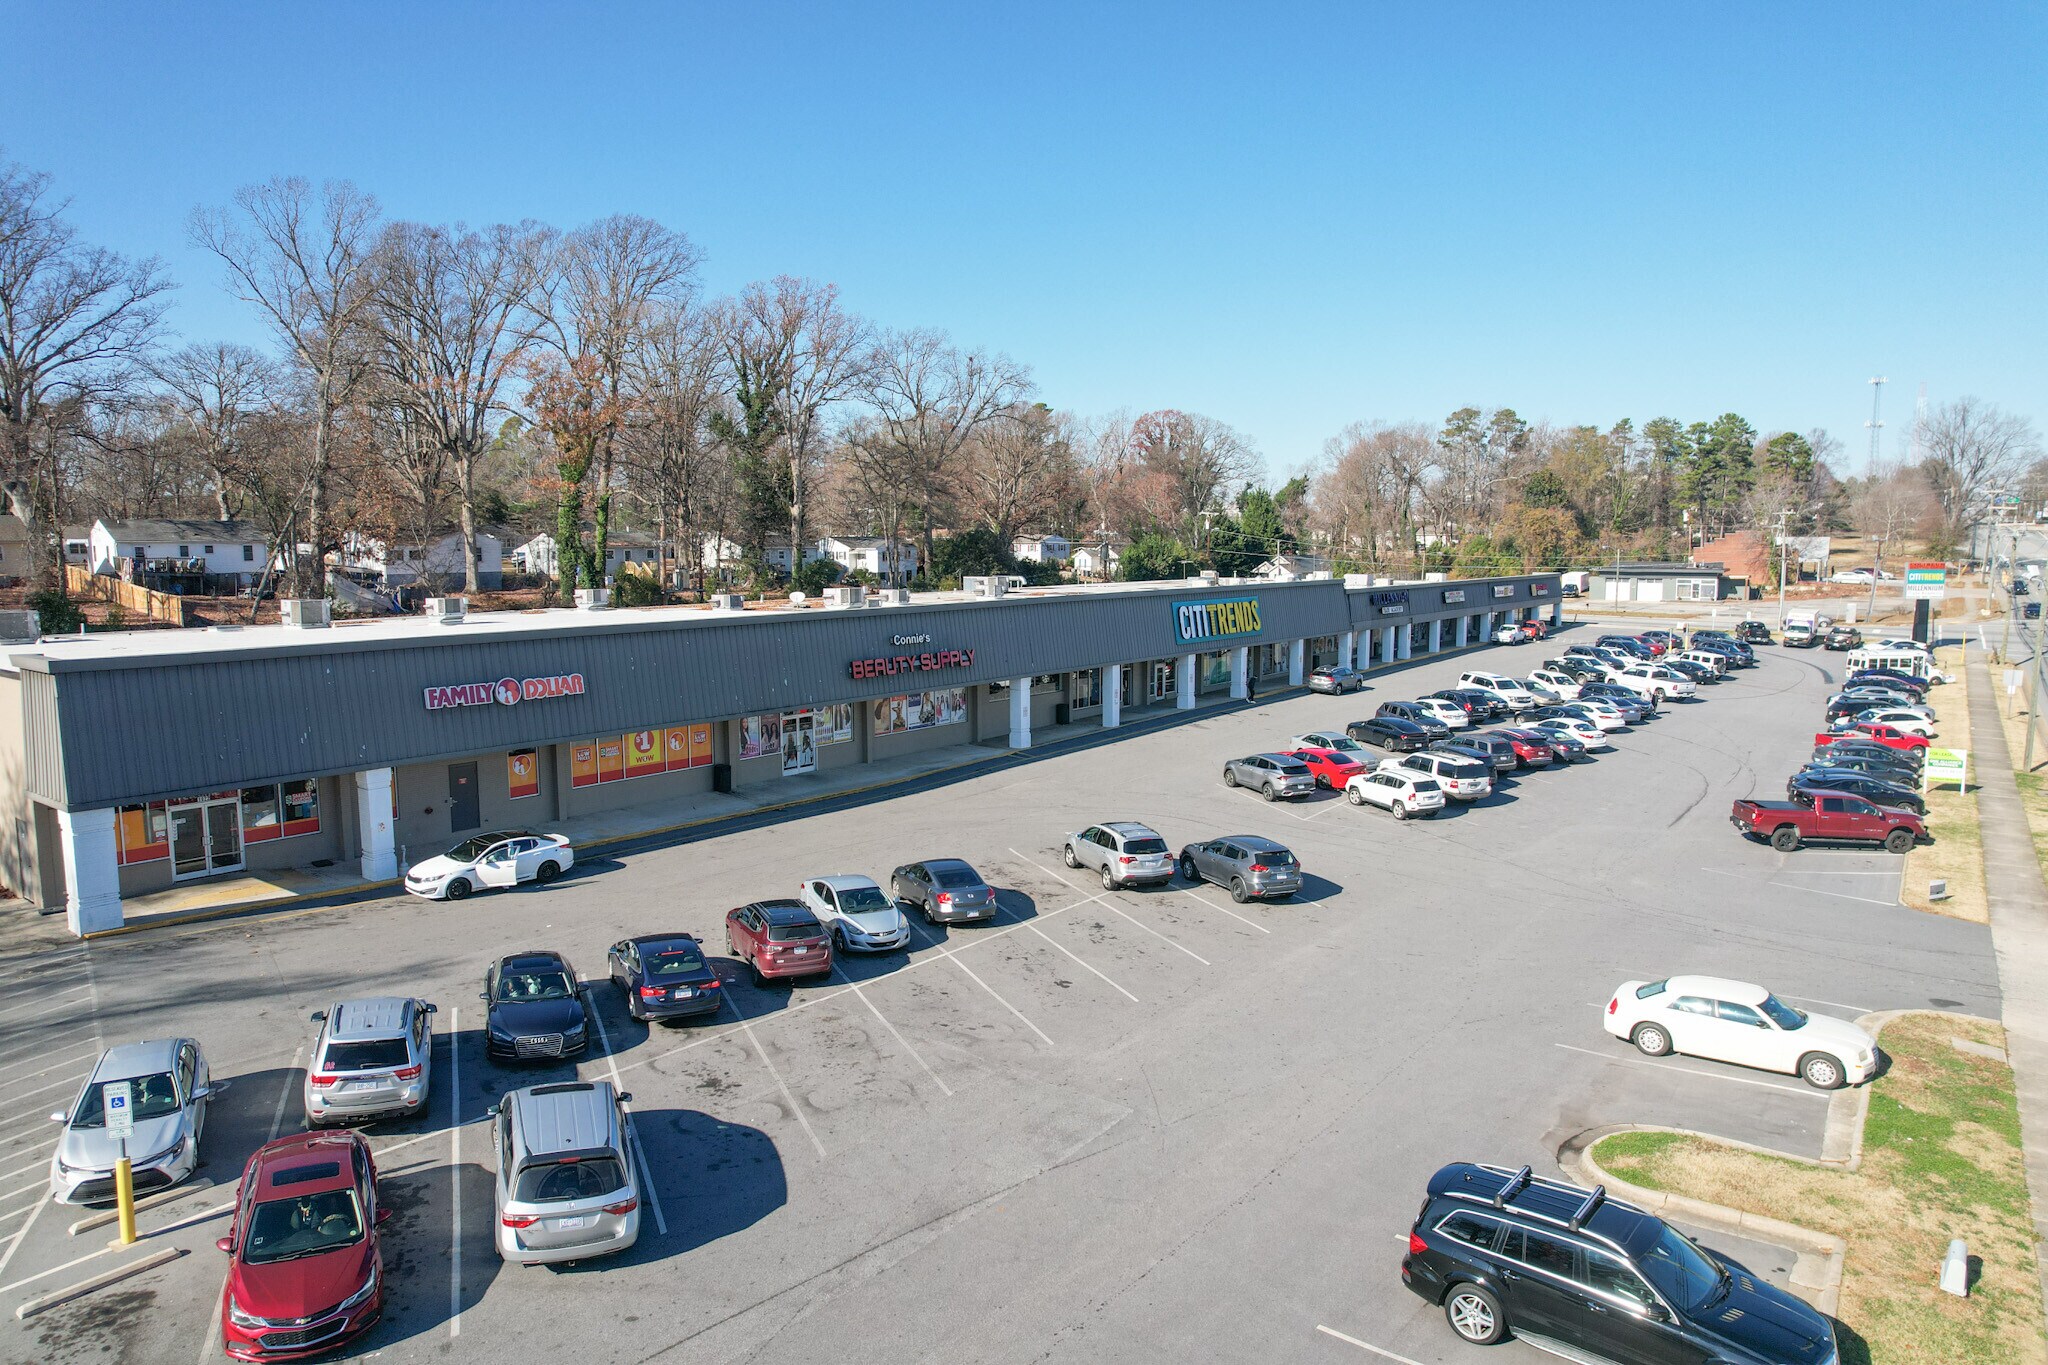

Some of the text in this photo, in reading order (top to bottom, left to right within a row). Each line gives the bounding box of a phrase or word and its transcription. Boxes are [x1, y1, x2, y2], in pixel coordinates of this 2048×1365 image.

[893, 633, 931, 646] Connie's
[852, 649, 975, 679] BEAUTY SUPPLY
[426, 673, 585, 709] FAMILY DOLLAR
[636, 755, 655, 763] WOW
